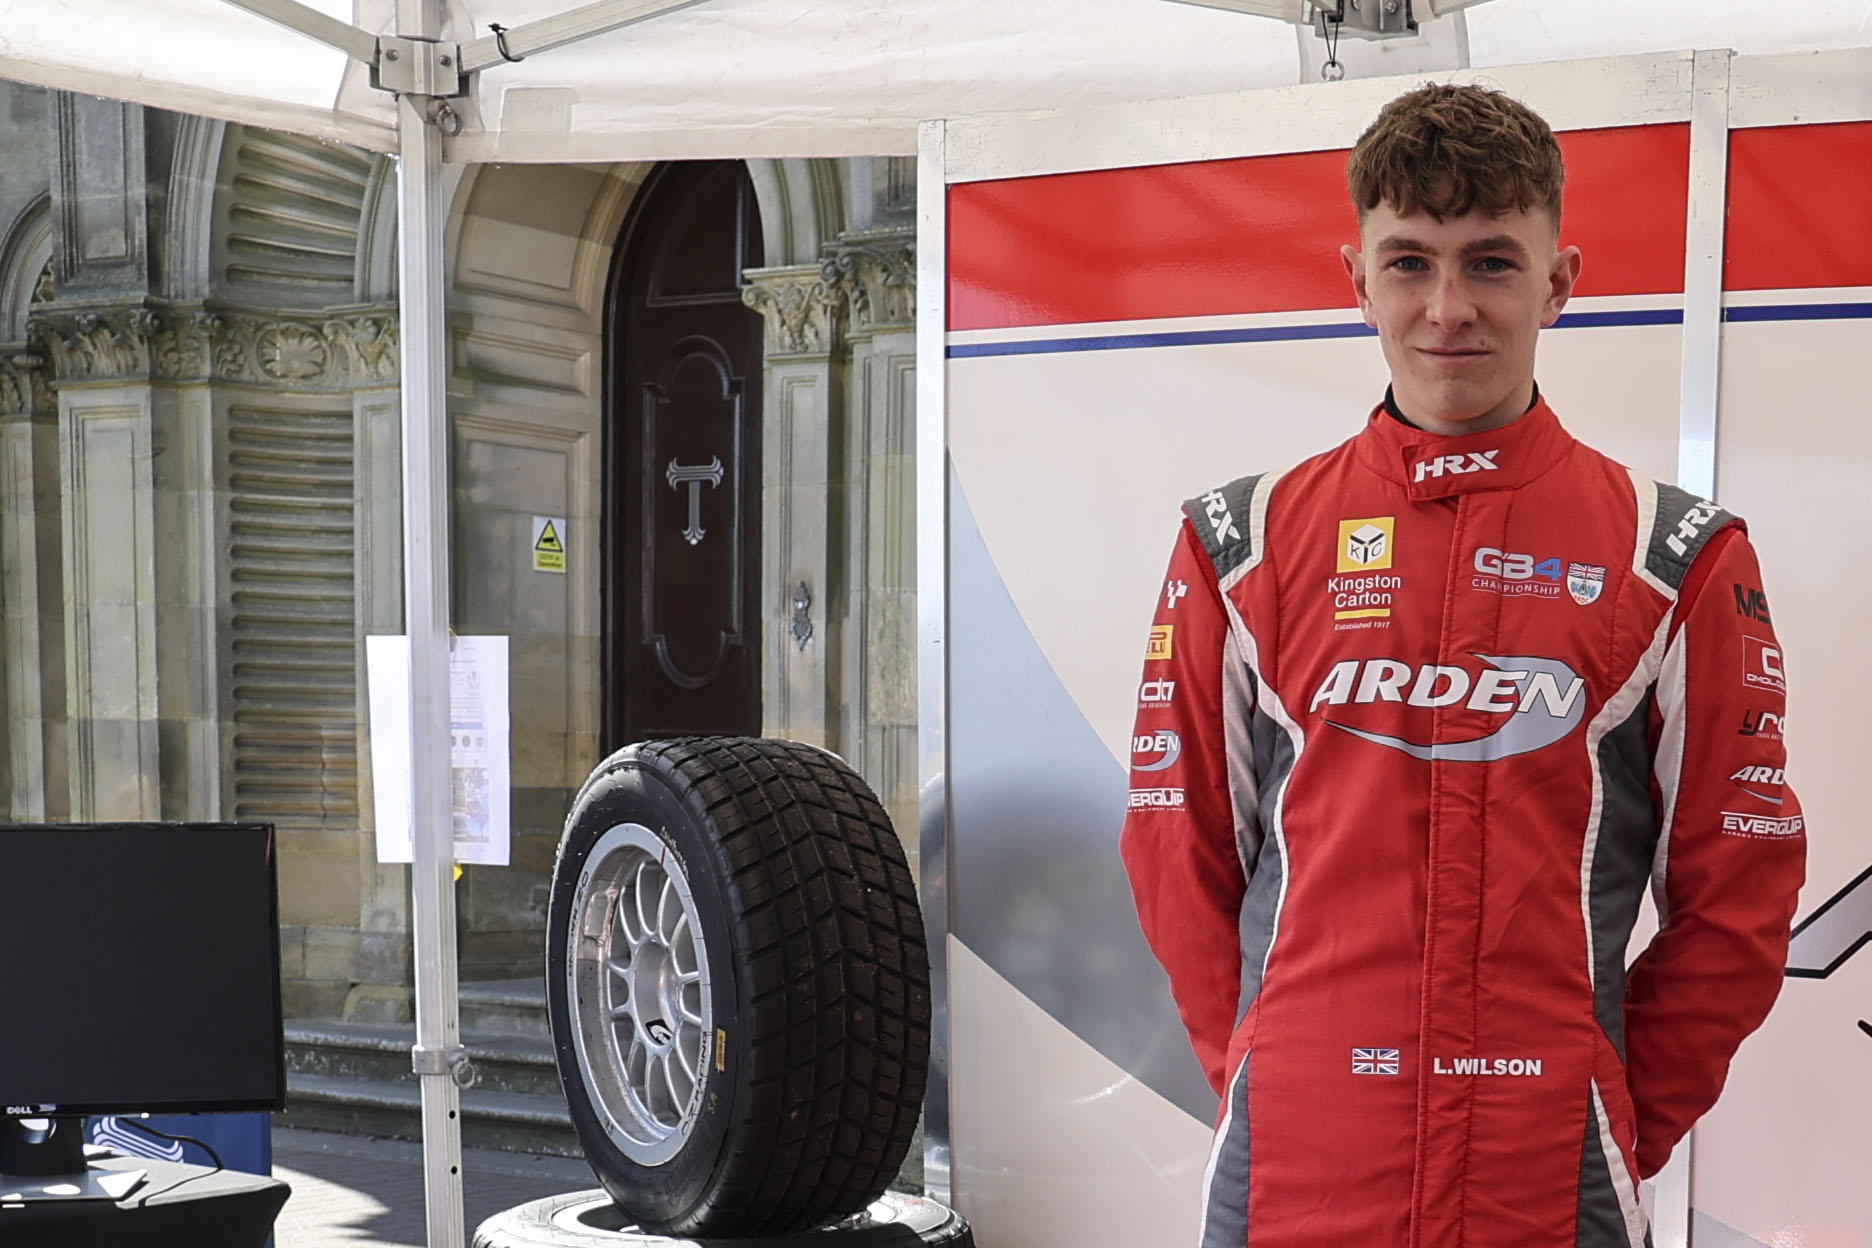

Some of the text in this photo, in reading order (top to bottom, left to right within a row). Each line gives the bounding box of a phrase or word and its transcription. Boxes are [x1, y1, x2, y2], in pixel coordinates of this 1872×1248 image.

[1414, 449, 1499, 483] HRX
[1665, 501, 1721, 557] HRX
[1474, 547, 1562, 580] GB4
[1327, 575, 1402, 593] Kingston
[1334, 591, 1392, 608] Carton
[1309, 658, 1585, 719] ARDEN
[1128, 788, 1185, 808] ERQUIP
[1722, 815, 1802, 835] EVERQUIP
[1433, 1057, 1542, 1076] L.WILSON
[6, 1106, 33, 1115] DELL
